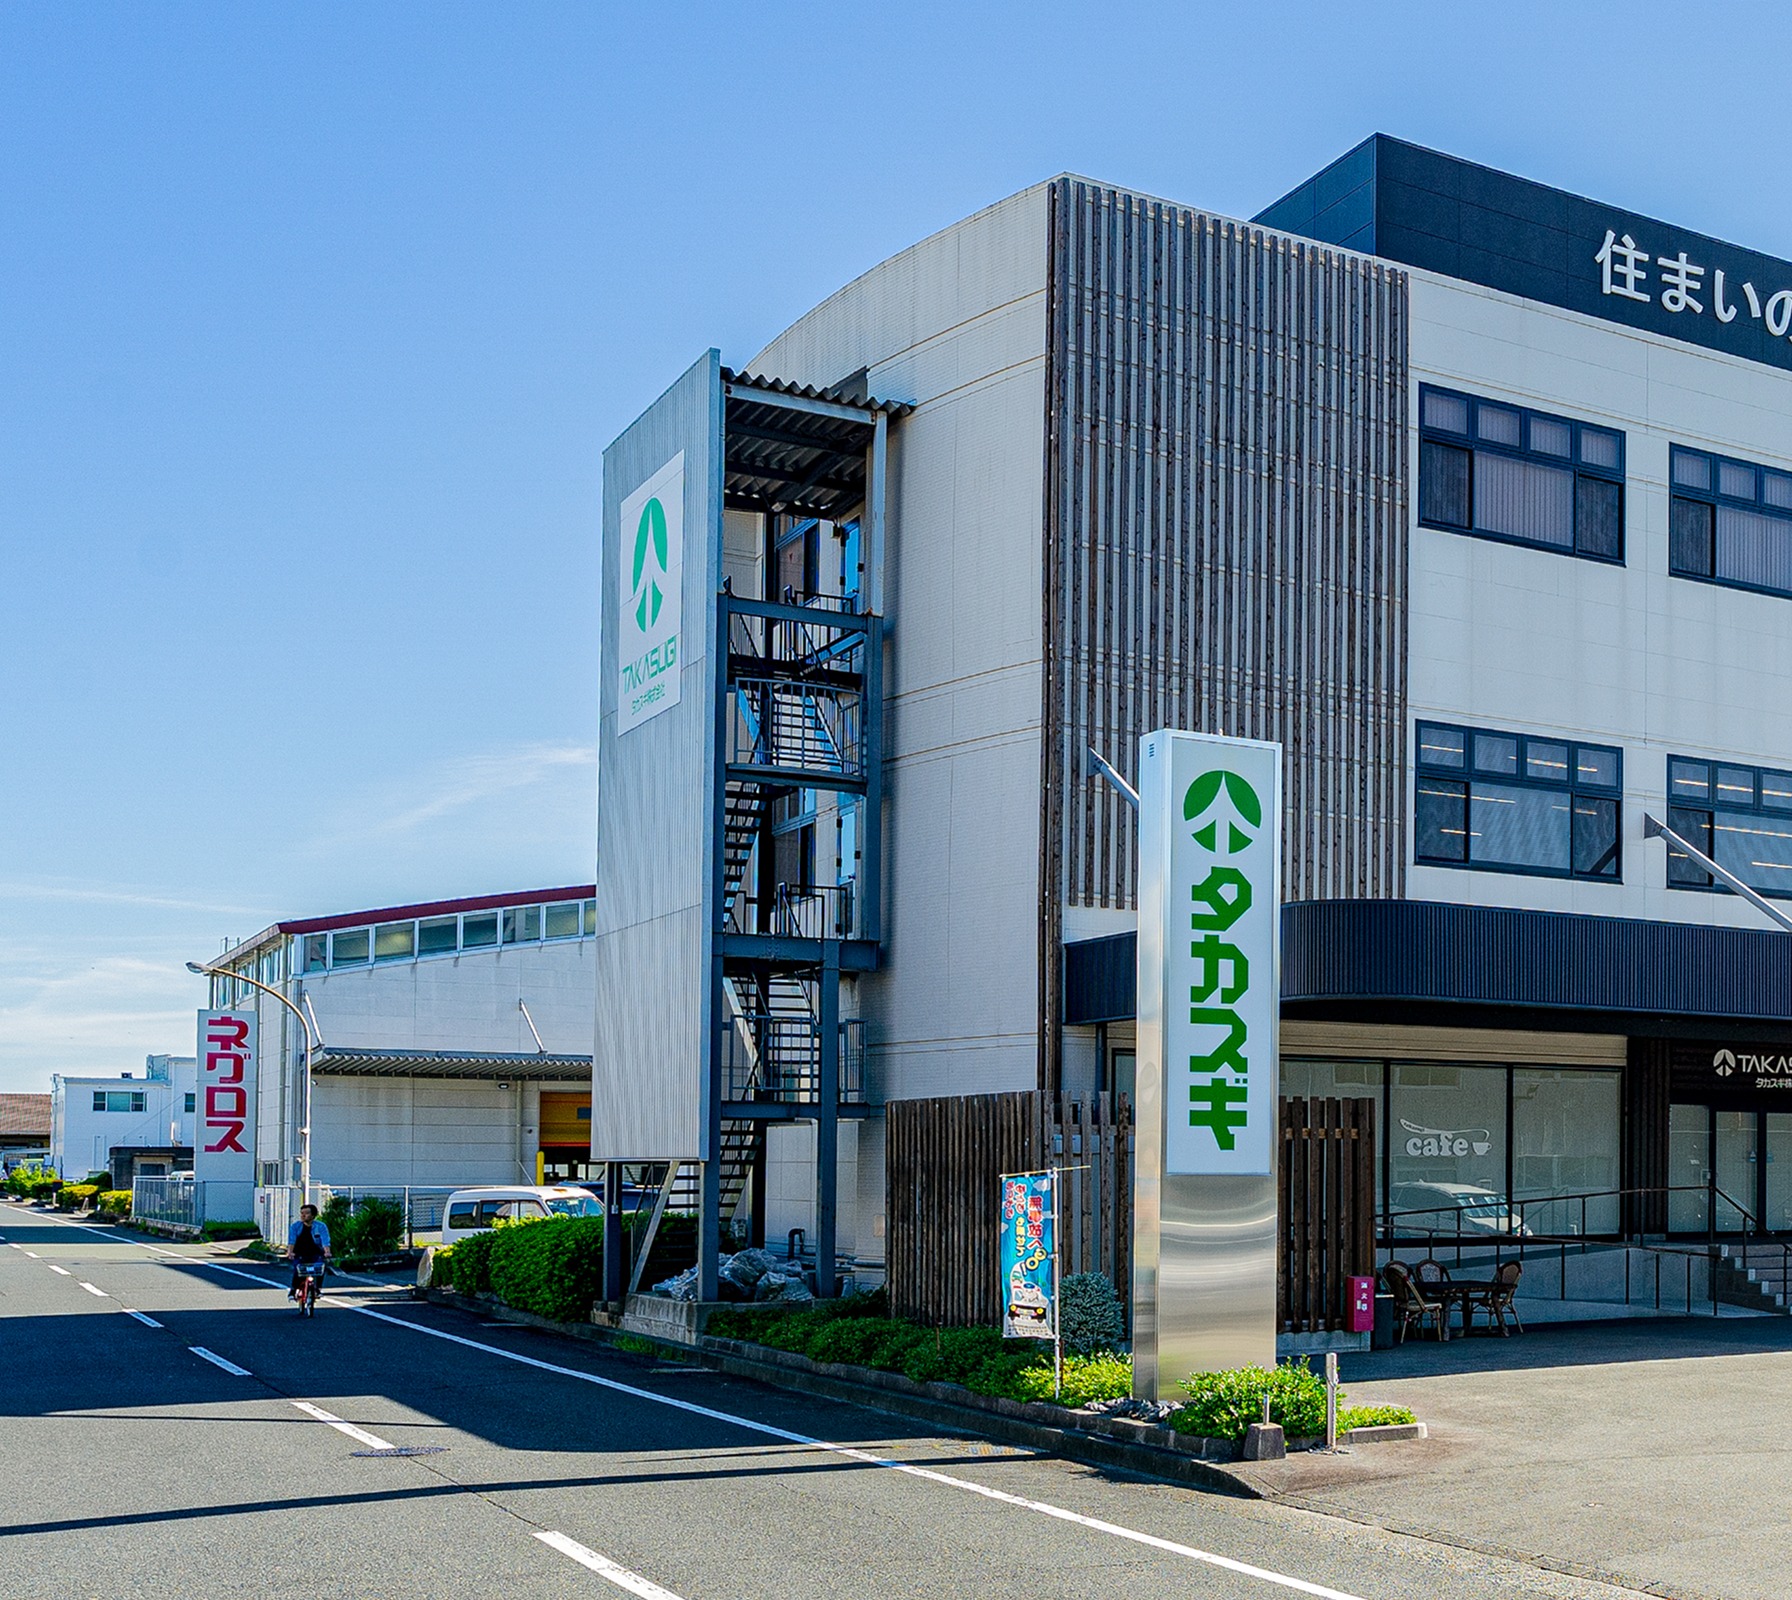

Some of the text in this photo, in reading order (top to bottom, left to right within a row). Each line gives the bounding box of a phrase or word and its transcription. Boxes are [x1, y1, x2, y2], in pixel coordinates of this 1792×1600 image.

[1189, 866, 1252, 1151] タカスギ
[204, 1016, 251, 1153] ネグロス
[1406, 1132, 1469, 1157] cafe
